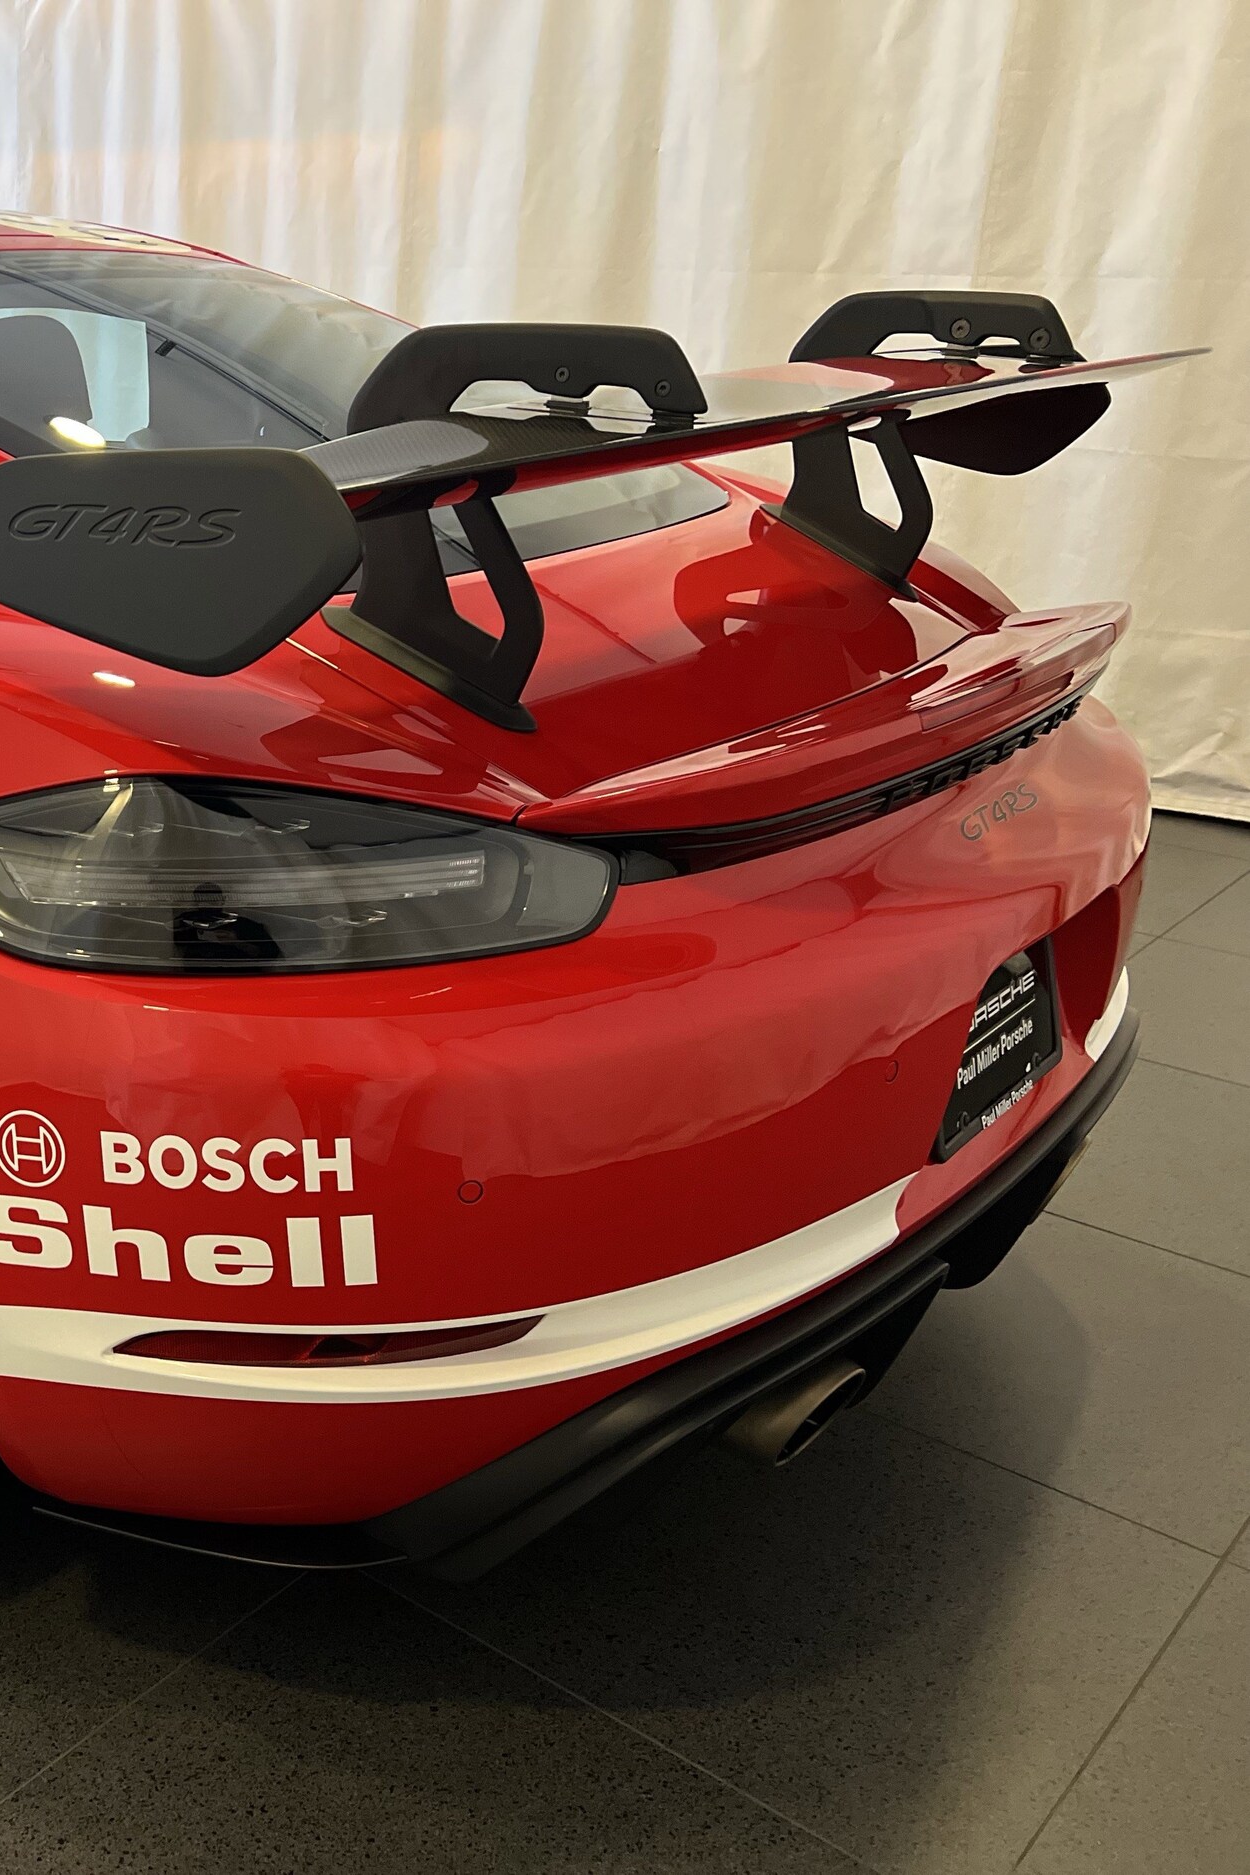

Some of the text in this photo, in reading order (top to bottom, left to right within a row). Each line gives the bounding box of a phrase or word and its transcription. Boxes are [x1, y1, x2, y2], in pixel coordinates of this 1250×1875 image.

[8, 503, 242, 549] GT4RS
[960, 783, 1038, 841] GT4RS
[957, 1018, 1033, 1089] Paul Miller Porsche
[100, 1130, 354, 1194] BOSCH
